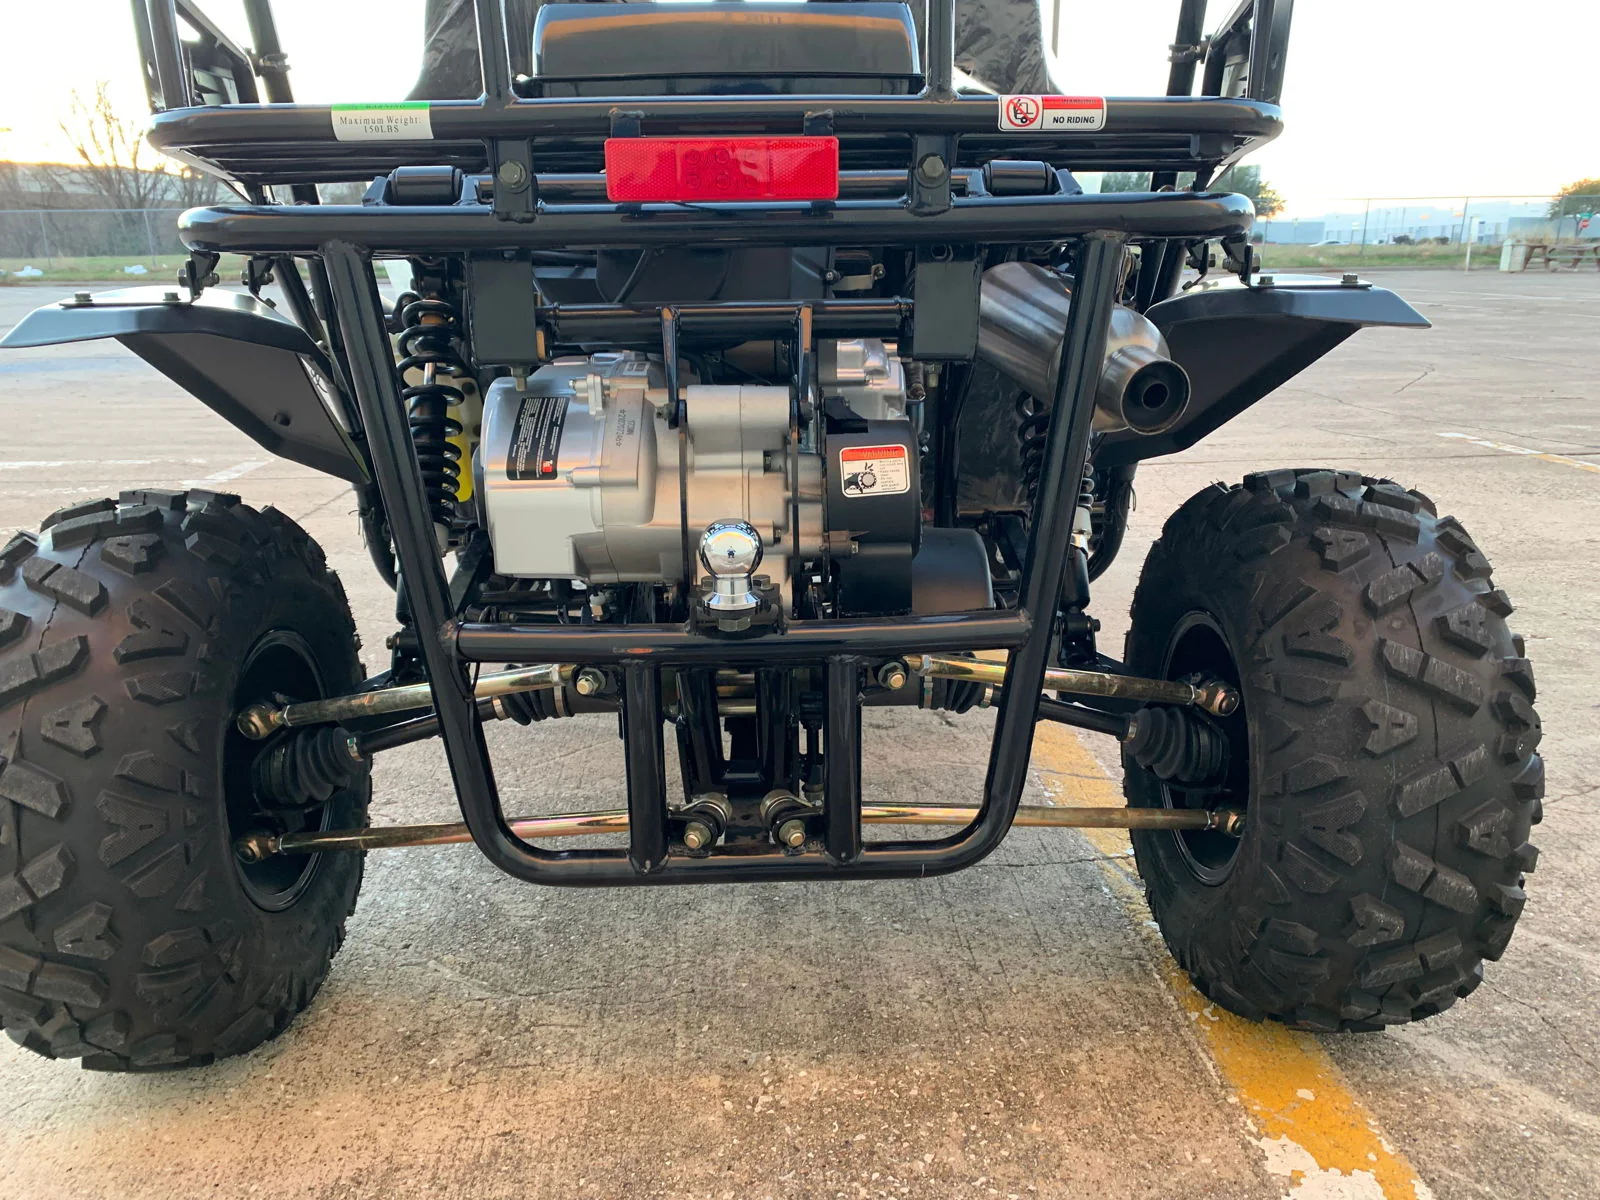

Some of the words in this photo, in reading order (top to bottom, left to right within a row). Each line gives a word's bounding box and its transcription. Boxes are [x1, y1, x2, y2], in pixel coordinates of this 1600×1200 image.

[340, 116, 384, 125] Maximum
[386, 115, 422, 126] Weight:
[1052, 116, 1065, 124] NO
[1066, 116, 1096, 124] RIDING
[364, 125, 400, 134] 150LBS
